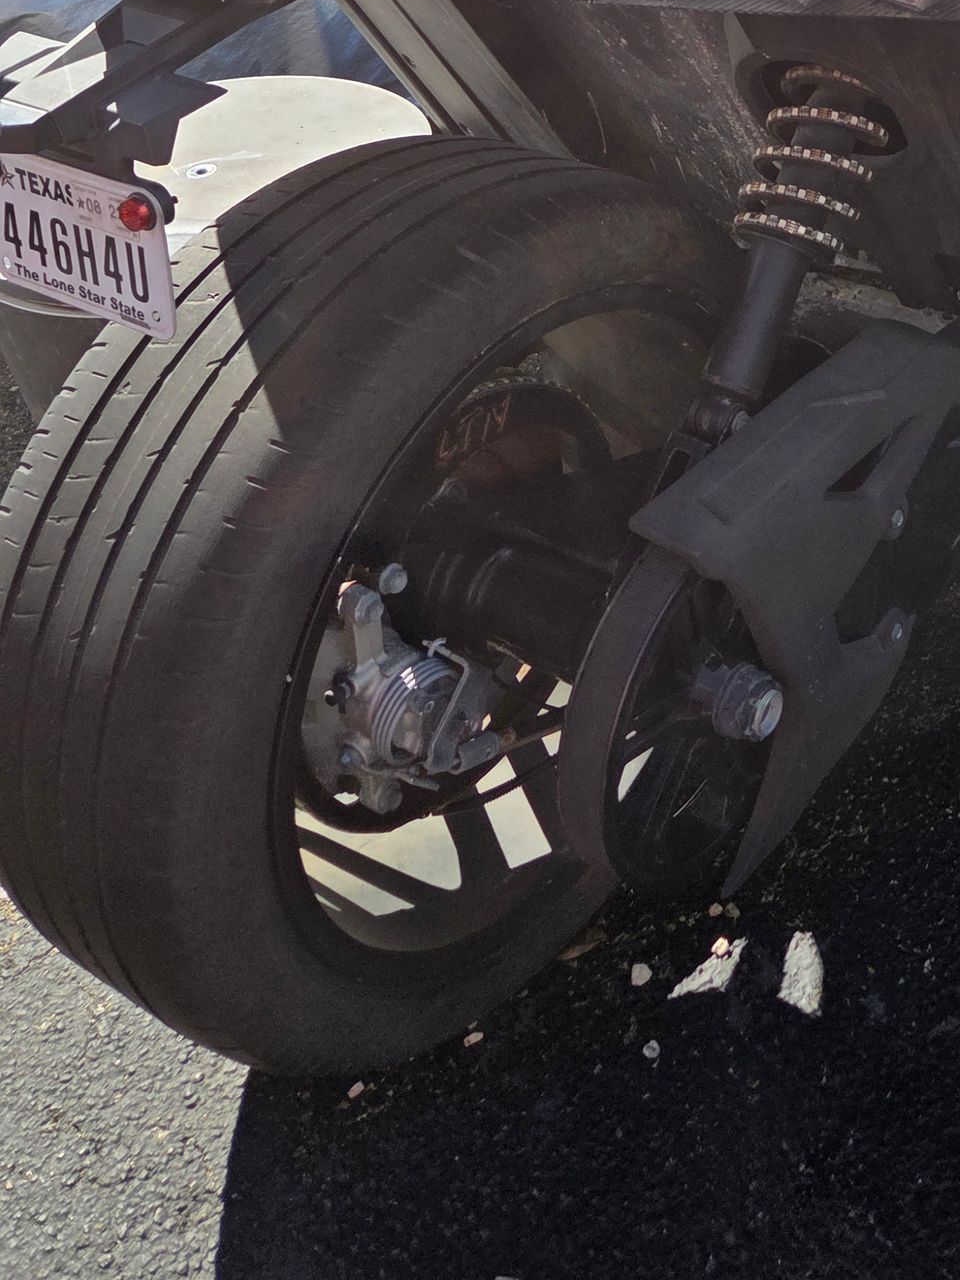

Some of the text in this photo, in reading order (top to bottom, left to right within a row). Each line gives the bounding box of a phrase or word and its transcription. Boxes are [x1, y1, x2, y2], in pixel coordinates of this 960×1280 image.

[15, 167, 74, 207] TEXAS
[4, 202, 150, 304] 446H4U
[14, 263, 145, 321] The Lone Star State
